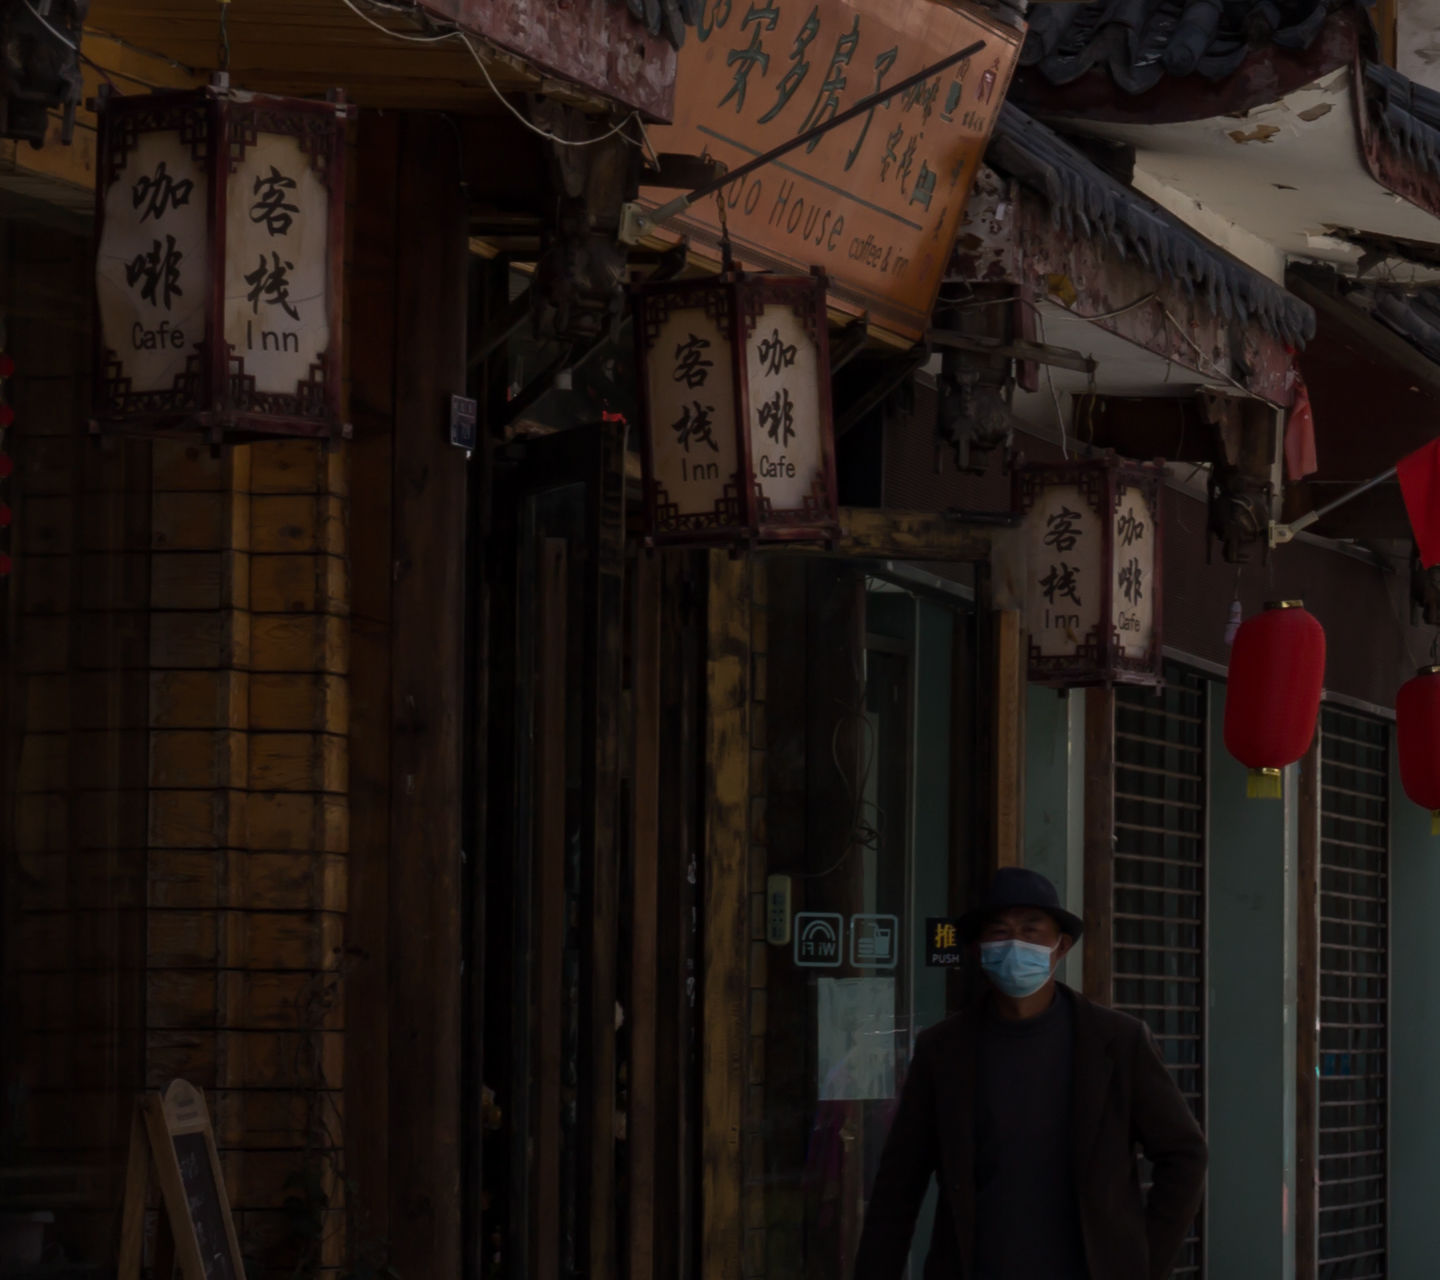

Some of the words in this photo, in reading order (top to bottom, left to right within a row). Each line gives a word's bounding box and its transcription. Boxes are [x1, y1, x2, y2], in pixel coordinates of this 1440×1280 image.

[125, 161, 194, 310] 咖啡
[244, 165, 300, 321] 客栈
[132, 320, 185, 350] Cafe
[247, 320, 299, 353] Inn
[672, 333, 719, 453] 客栈
[757, 328, 797, 448] 咖啡
[682, 458, 719, 482] Inn
[759, 455, 796, 478] Cafe
[1039, 506, 1083, 606] 客栈
[1117, 507, 1144, 606] 咖啡
[1045, 609, 1080, 628] Inn
[1119, 611, 1141, 632] Cafe
[934, 923, 957, 949] 推
[931, 953, 960, 964] PUSH
